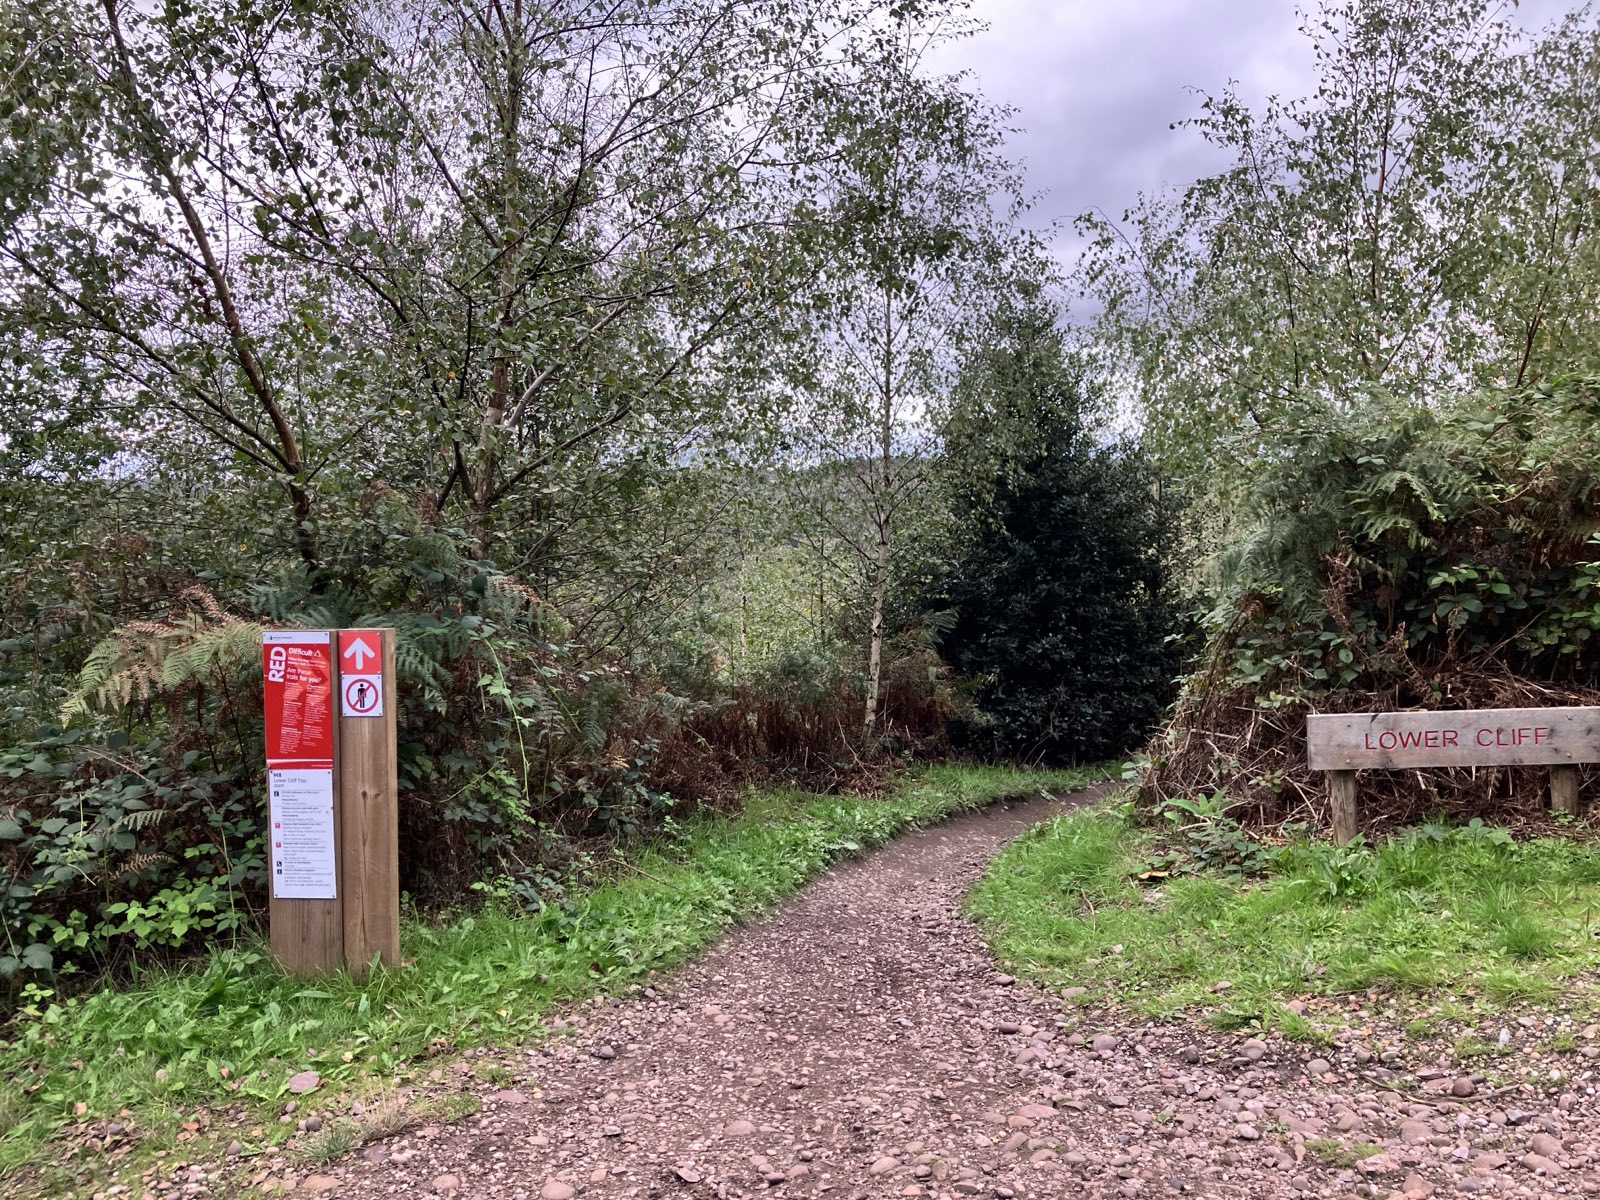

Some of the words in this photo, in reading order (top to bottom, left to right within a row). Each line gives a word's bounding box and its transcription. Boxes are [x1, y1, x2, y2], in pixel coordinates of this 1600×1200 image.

[288, 647, 313, 656] Difficult
[268, 646, 286, 682] RED
[1364, 729, 1459, 750] LOWER
[1476, 727, 1548, 747] CLIFF
